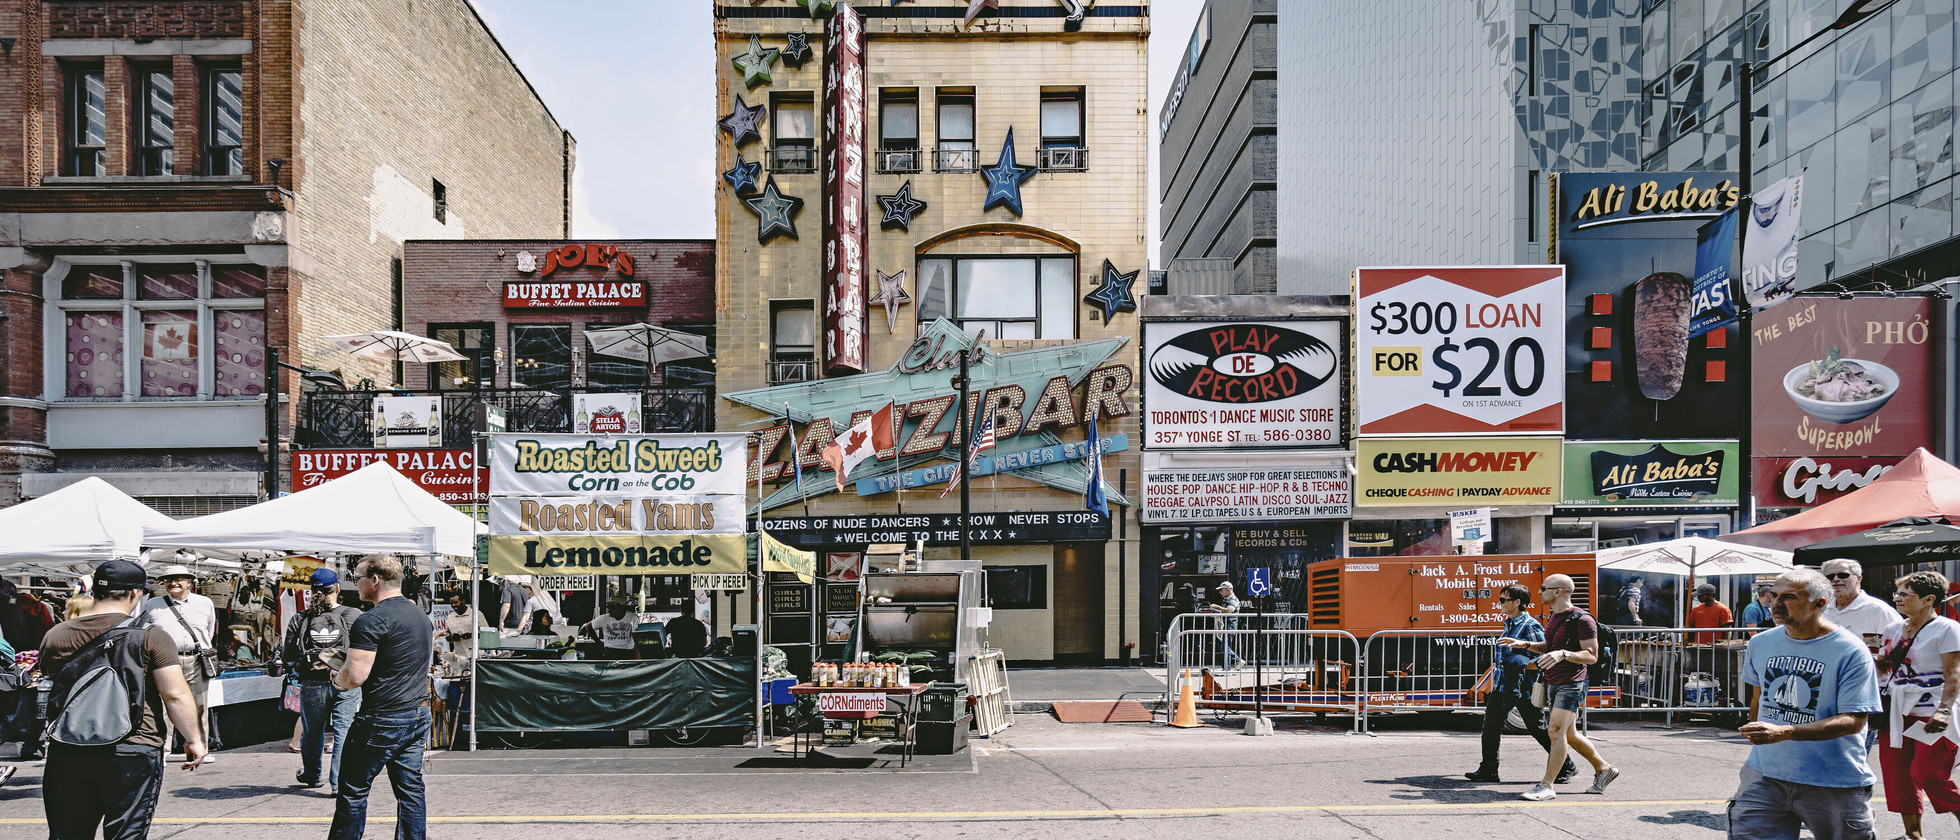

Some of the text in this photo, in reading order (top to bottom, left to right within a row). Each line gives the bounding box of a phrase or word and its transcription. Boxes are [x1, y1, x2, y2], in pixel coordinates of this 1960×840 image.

[841, 13, 864, 365] ZANZIBAR
[1577, 176, 1740, 220] Ali Baba's
[541, 244, 635, 277] JOE'S
[1717, 272, 1726, 283] OF
[507, 282, 642, 299] BUFFET PALACE
[528, 299, 620, 307] Fine Indian Cuisine
[1370, 301, 1542, 335] $300 LOAN
[1702, 315, 1721, 327] YONGE
[1753, 304, 1817, 348] THE BEST
[1209, 327, 1280, 355] PLAY
[899, 328, 985, 374] Club
[1232, 355, 1256, 374] DE
[1374, 336, 1545, 398] FOR $20
[1187, 364, 1297, 403] RECORD
[1151, 408, 1334, 425] TORONTO'S DANCE MUSIC STORE
[1186, 430, 1223, 443] YONGE
[1244, 433, 1261, 442] TEL:
[1263, 429, 1332, 442] 586-0380
[1797, 416, 1882, 452] SUPERBOWL
[299, 452, 486, 471] BUFFET PALAC
[515, 439, 723, 473] Roasted Sweet
[875, 437, 1113, 492] THE GIRS NEVER STP
[1148, 470, 1348, 483] WHERE THE DEEJAYS SHOP FOR GREAT SELECTIONS IN
[1602, 456, 1719, 486] Ali Baba's
[568, 474, 620, 491] Corn
[635, 478, 650, 487] the
[651, 473, 695, 491] Cob
[1283, 482, 1289, 492] R
[1292, 482, 1299, 492] &
[1365, 486, 1551, 498] CHEQUE CASHING PAYDAY ADVANCE
[1626, 486, 1693, 498] Middle Eastern Cuisine
[519, 499, 715, 532] Roasted Yams
[1148, 509, 1169, 519] VINYL
[1256, 506, 1262, 515] &
[1267, 506, 1311, 516] EUROPEAN
[1313, 505, 1348, 515] IMPORTS
[1452, 509, 1478, 518] BUSKER
[813, 519, 829, 530] OF
[833, 518, 867, 529] NUDE
[871, 517, 930, 528] DANCERS
[1008, 514, 1049, 525] NEVER
[1057, 513, 1099, 524] STOPS
[844, 529, 1003, 543] WELCOME TO THE X X
[1250, 529, 1307, 538] BUY & SELL
[1279, 539, 1287, 547] &
[1289, 538, 1308, 546] CDs
[523, 539, 712, 569] Lemonade
[1420, 562, 1534, 577] Jack A. Frost Ltd.
[539, 576, 588, 589] ORDER HERE
[692, 575, 742, 589] PICK UP HERE
[1435, 578, 1518, 589] Mobile Power
[1419, 602, 1476, 612] Rentals Sales
[1766, 655, 1826, 676] ANTIGUA
[820, 695, 885, 711] CORNdiments
[1762, 706, 1780, 720] WEST
[824, 728, 851, 737] CLASSIC
